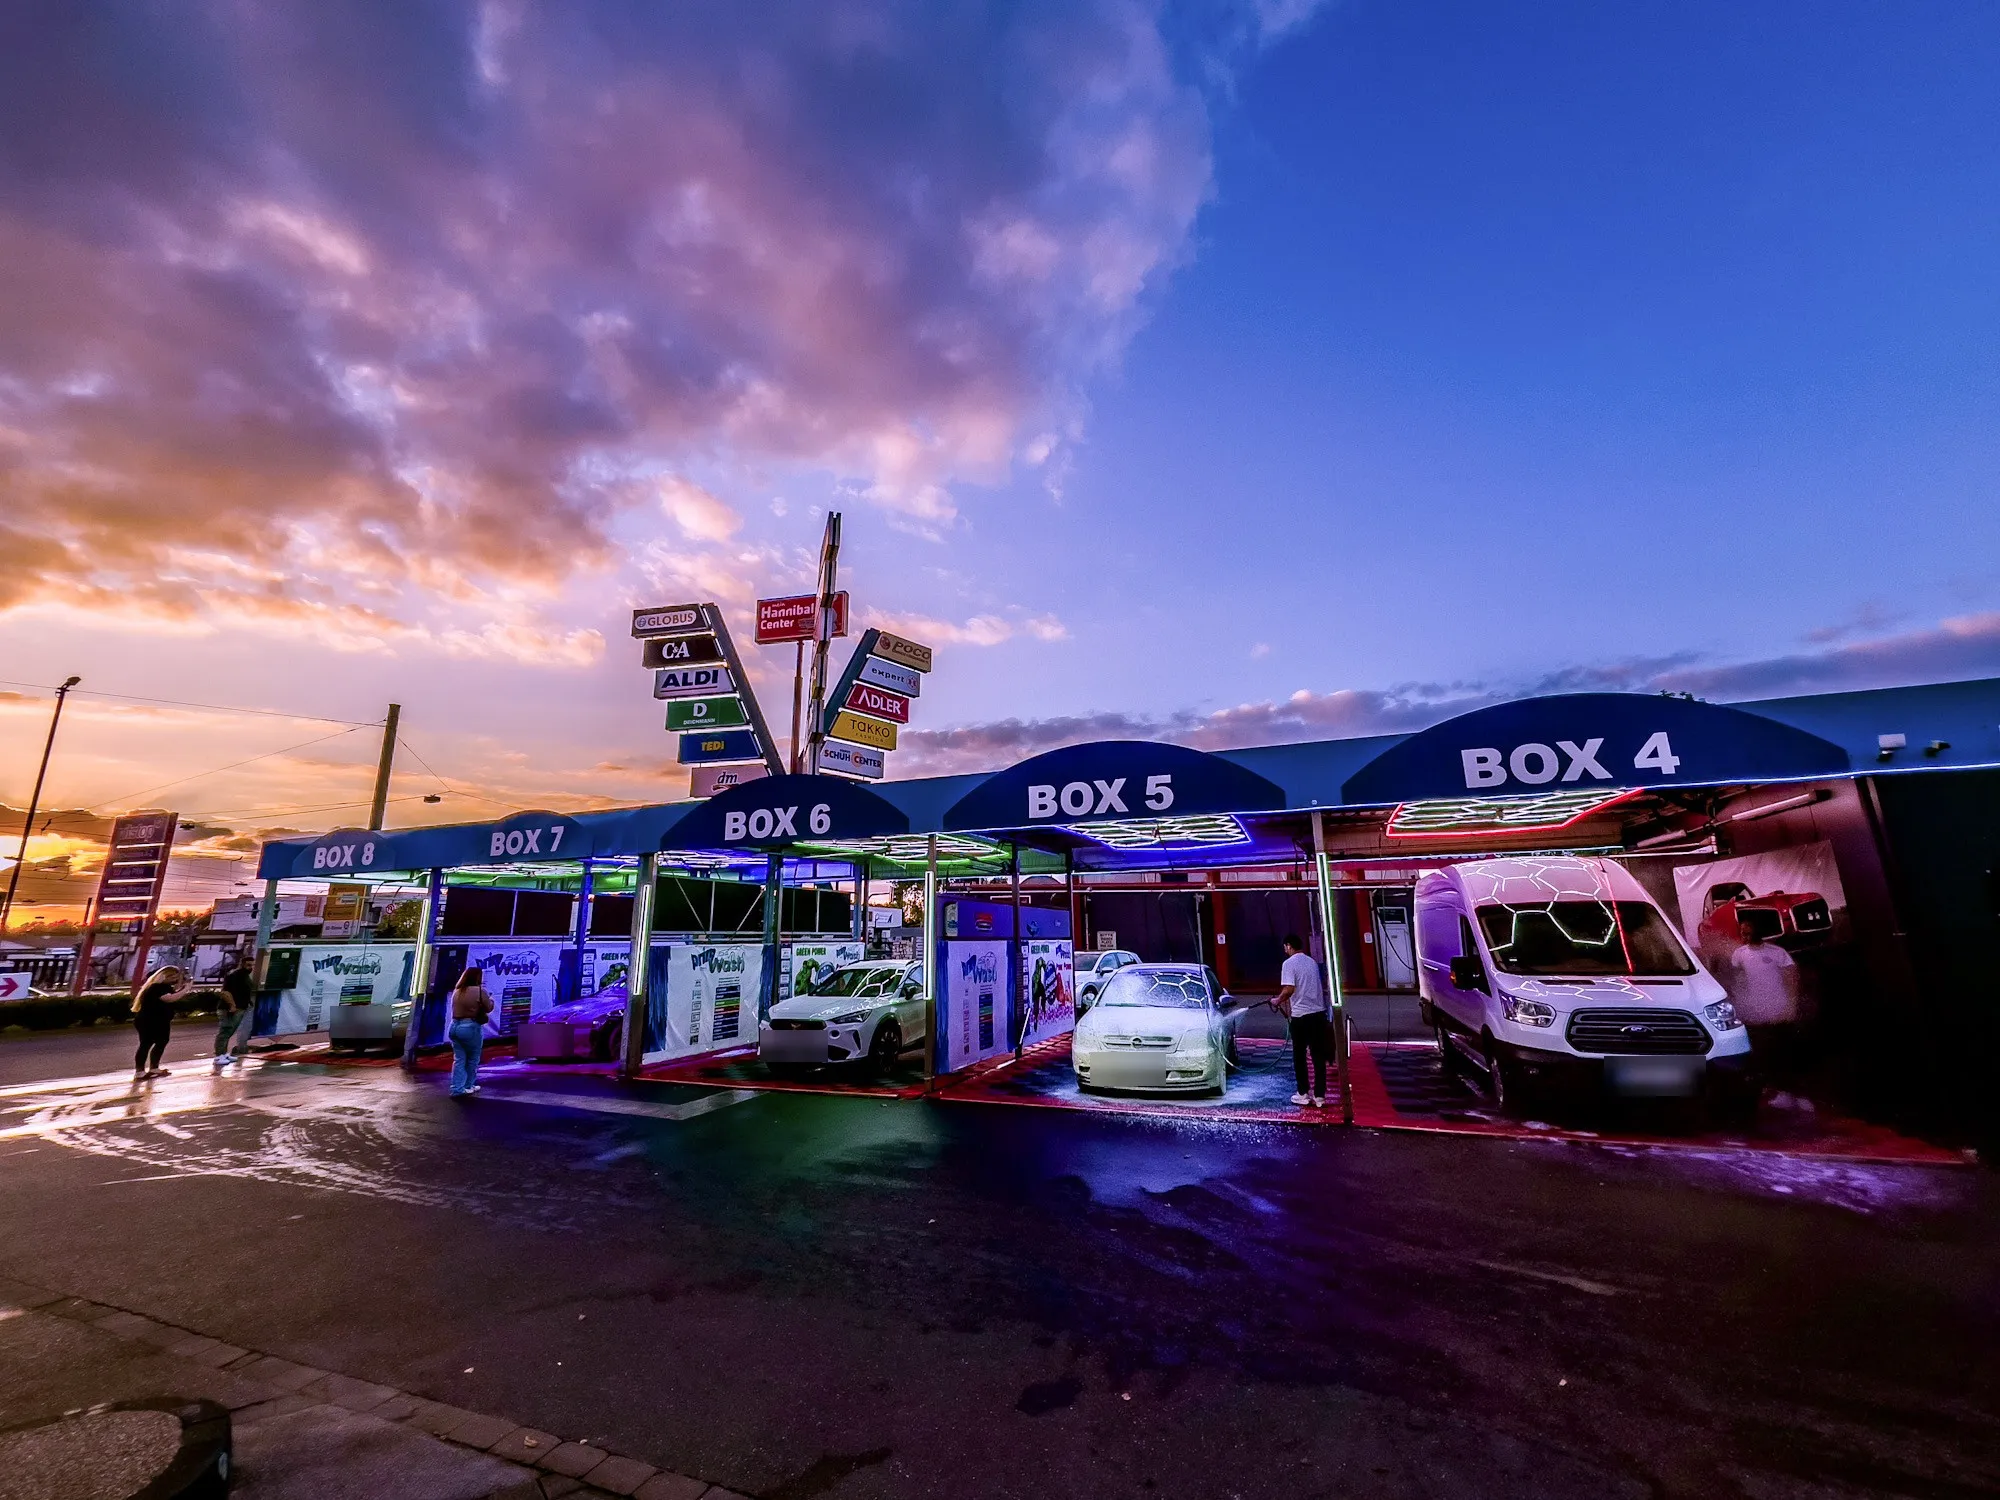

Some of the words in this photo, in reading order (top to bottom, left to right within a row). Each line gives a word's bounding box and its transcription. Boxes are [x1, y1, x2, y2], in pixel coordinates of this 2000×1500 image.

[648, 613, 693, 626] GLOBUS
[761, 603, 815, 619] Hannibal
[760, 619, 794, 630] Center
[662, 641, 690, 659] C&A
[892, 641, 930, 659] POCO
[661, 669, 719, 688] ALDI
[871, 667, 905, 683] expert
[693, 703, 708, 717] D
[858, 689, 901, 715] ADLER
[1461, 738, 1613, 788] BOX
[1634, 732, 1680, 774] 4
[717, 771, 737, 783] dm
[1029, 778, 1130, 818] BOX
[1145, 775, 1173, 810] 5
[725, 806, 798, 840] BOX
[810, 804, 830, 834] 6
[490, 829, 541, 856] BOX
[550, 826, 564, 851] 7
[314, 845, 356, 868] BOX
[362, 843, 374, 865] 8
